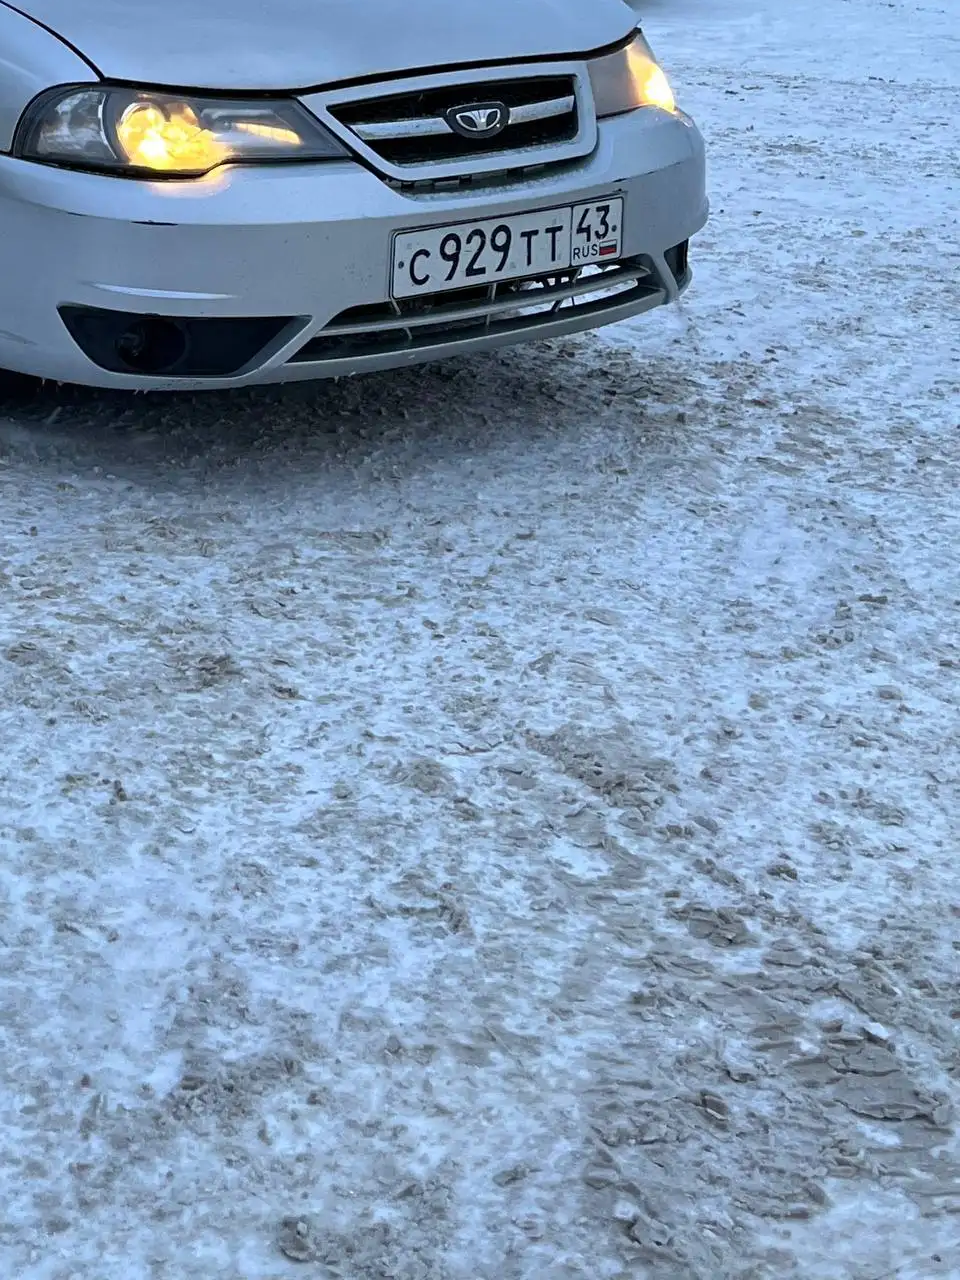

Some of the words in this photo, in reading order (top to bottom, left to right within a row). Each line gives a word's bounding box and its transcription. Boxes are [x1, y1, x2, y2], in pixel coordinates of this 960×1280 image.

[576, 204, 611, 242] 43
[409, 224, 563, 285] С929ТТ
[573, 243, 598, 260] RUS
